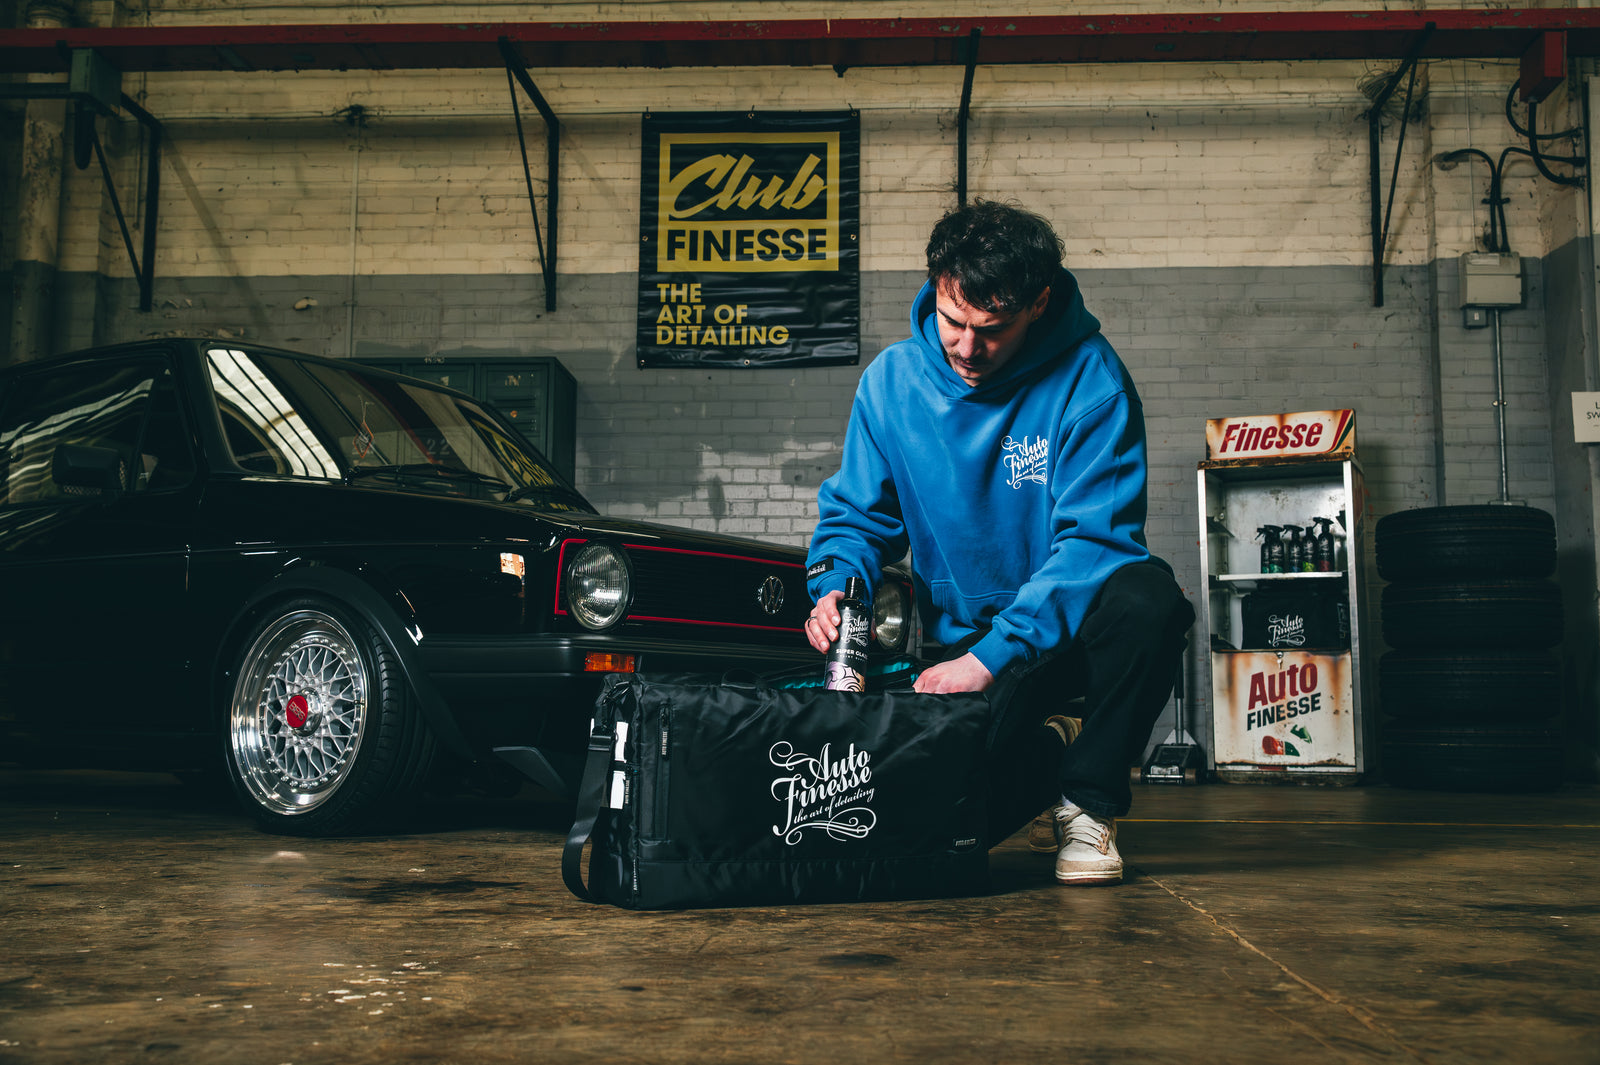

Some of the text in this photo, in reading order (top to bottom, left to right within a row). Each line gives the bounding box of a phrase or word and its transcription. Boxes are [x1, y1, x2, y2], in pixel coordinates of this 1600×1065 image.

[669, 153, 827, 218] Club
[667, 228, 827, 261] FINESSE
[656, 283, 702, 303] THE
[656, 304, 748, 324] ART OF
[656, 325, 790, 345] DETAILING
[1009, 435, 1048, 457] Auto
[1219, 422, 1323, 453] Finesse
[1004, 452, 1048, 485] Finesse
[1248, 663, 1318, 710] Auto
[1247, 692, 1321, 731] FINESSE
[787, 742, 871, 786] Auto
[771, 774, 872, 836] Finesse
[794, 788, 875, 824] the art of detailing
